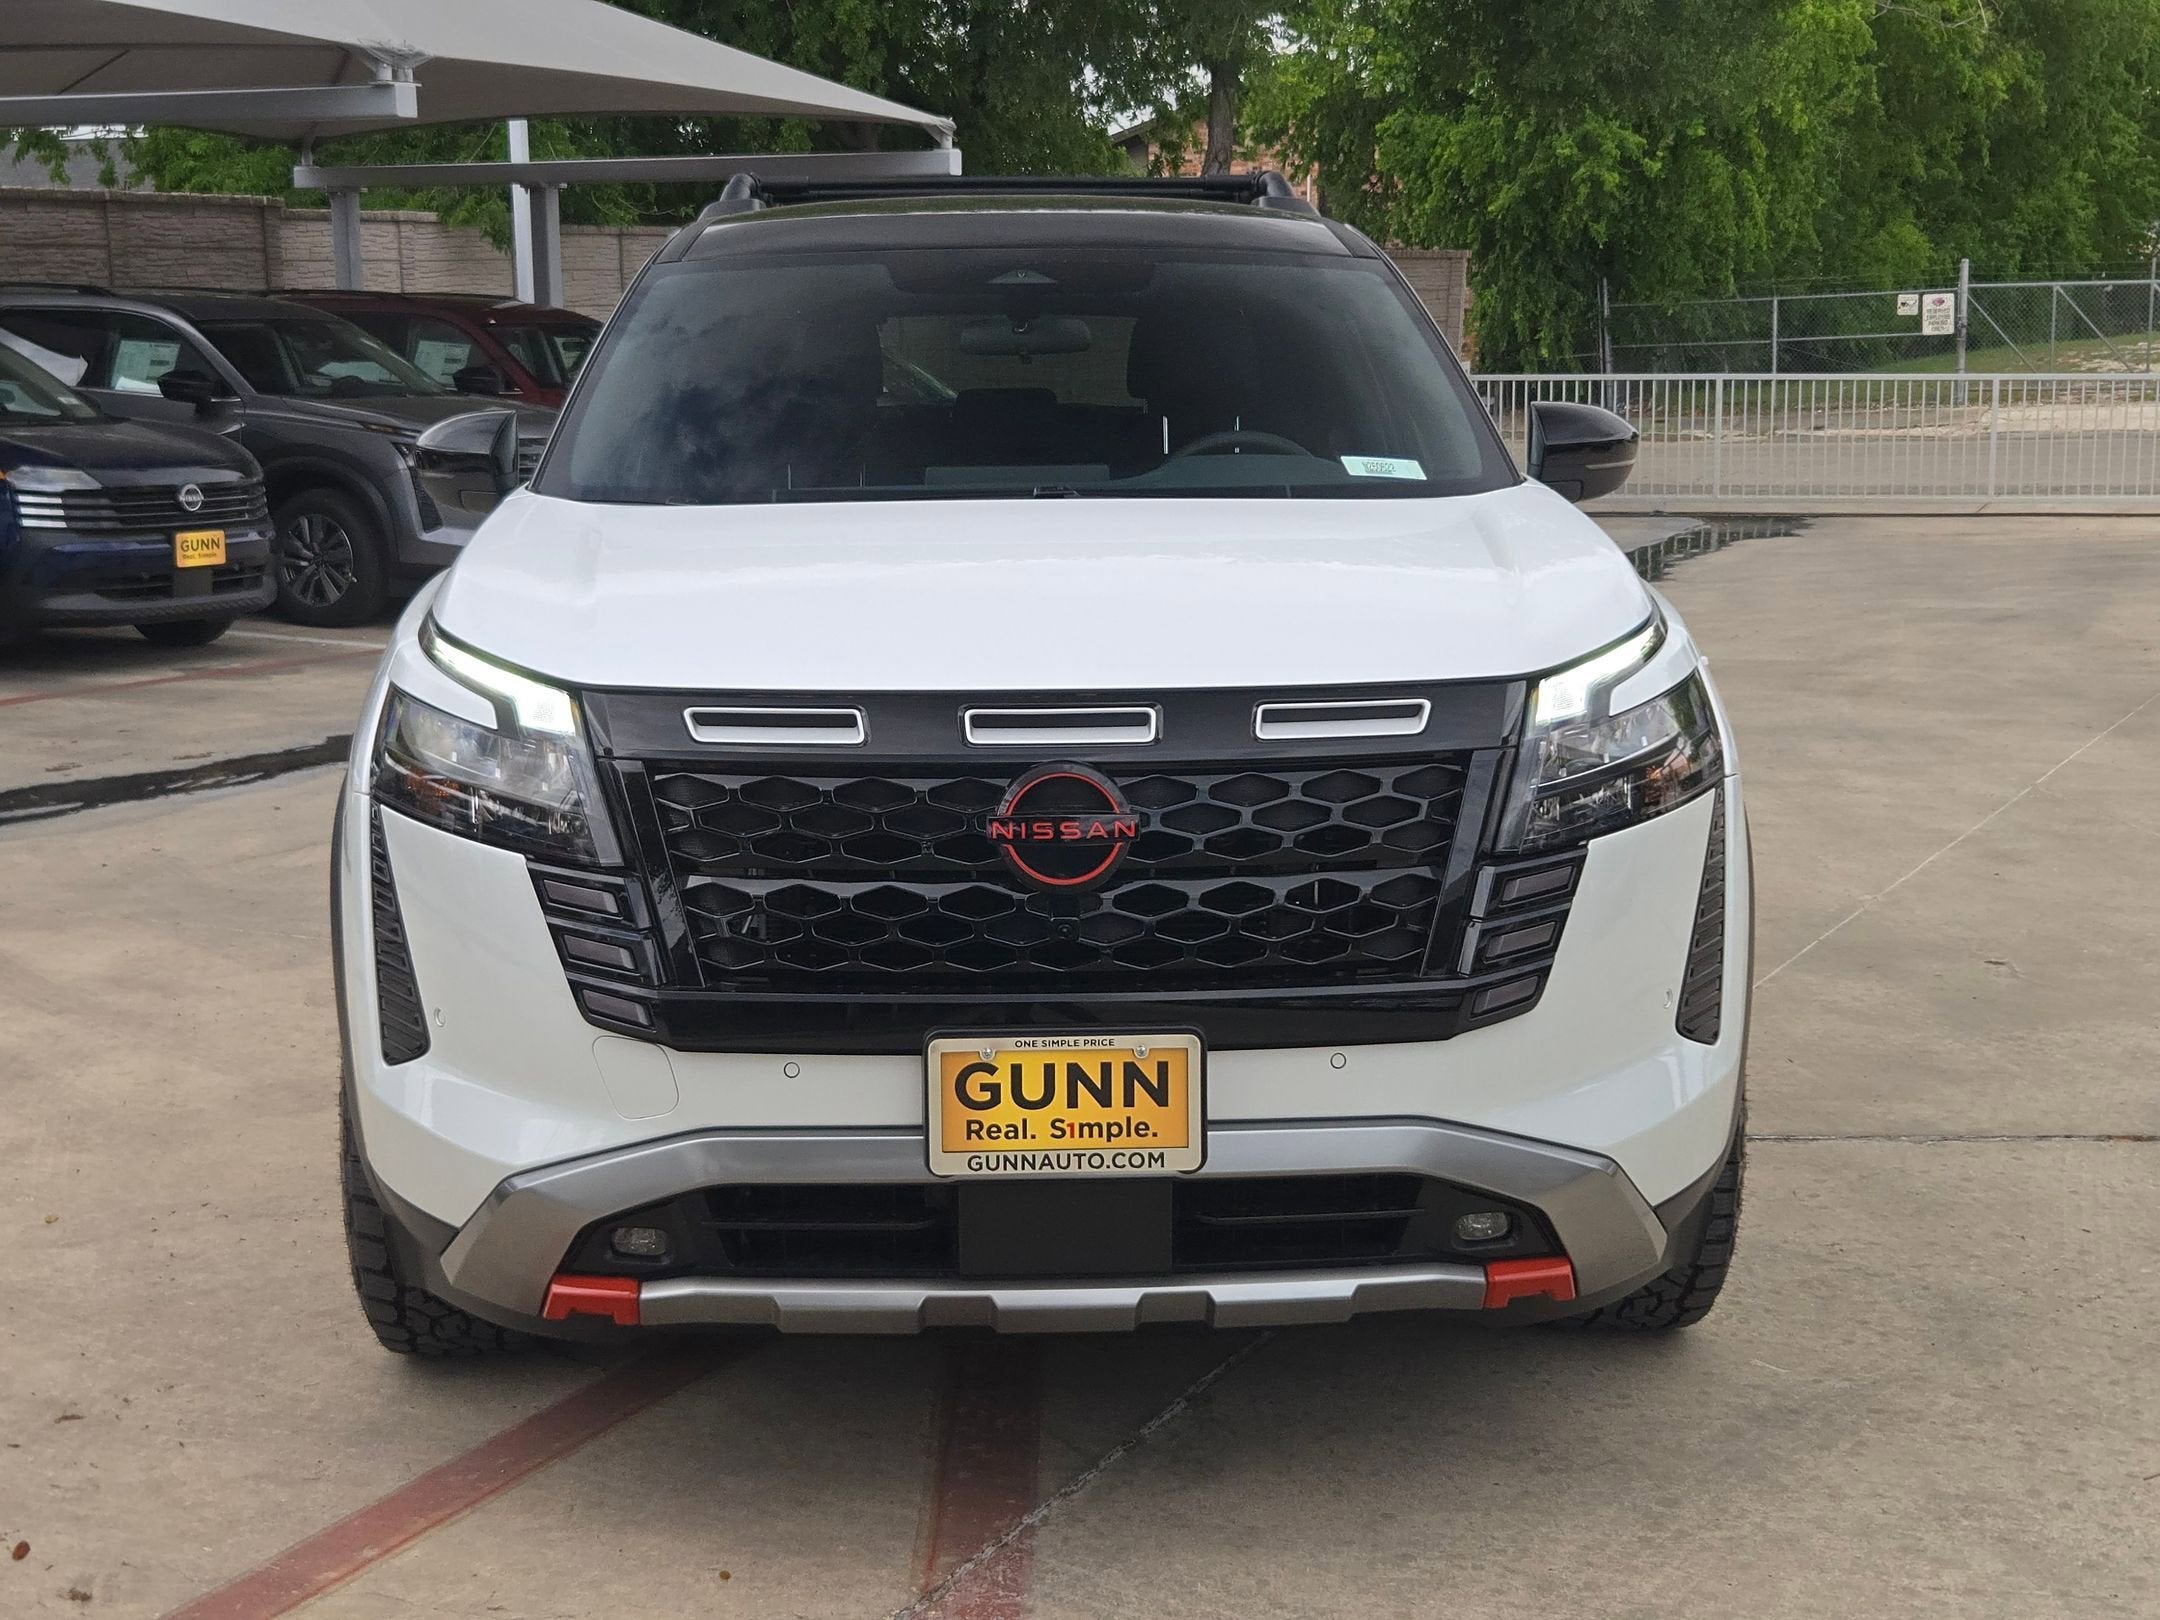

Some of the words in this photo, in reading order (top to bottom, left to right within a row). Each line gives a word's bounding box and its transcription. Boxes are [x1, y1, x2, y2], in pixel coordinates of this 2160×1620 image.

[180, 538, 220, 553] GUNN
[990, 819, 1136, 841] NISSAN
[1014, 1039, 1038, 1048] ONE
[1041, 1039, 1080, 1047] SIMPLE
[1083, 1038, 1115, 1047] PRICE
[954, 1060, 1169, 1111] GUNN
[965, 1118, 1037, 1141] Real.
[967, 1151, 1166, 1172] GUNNAUTO.COM
